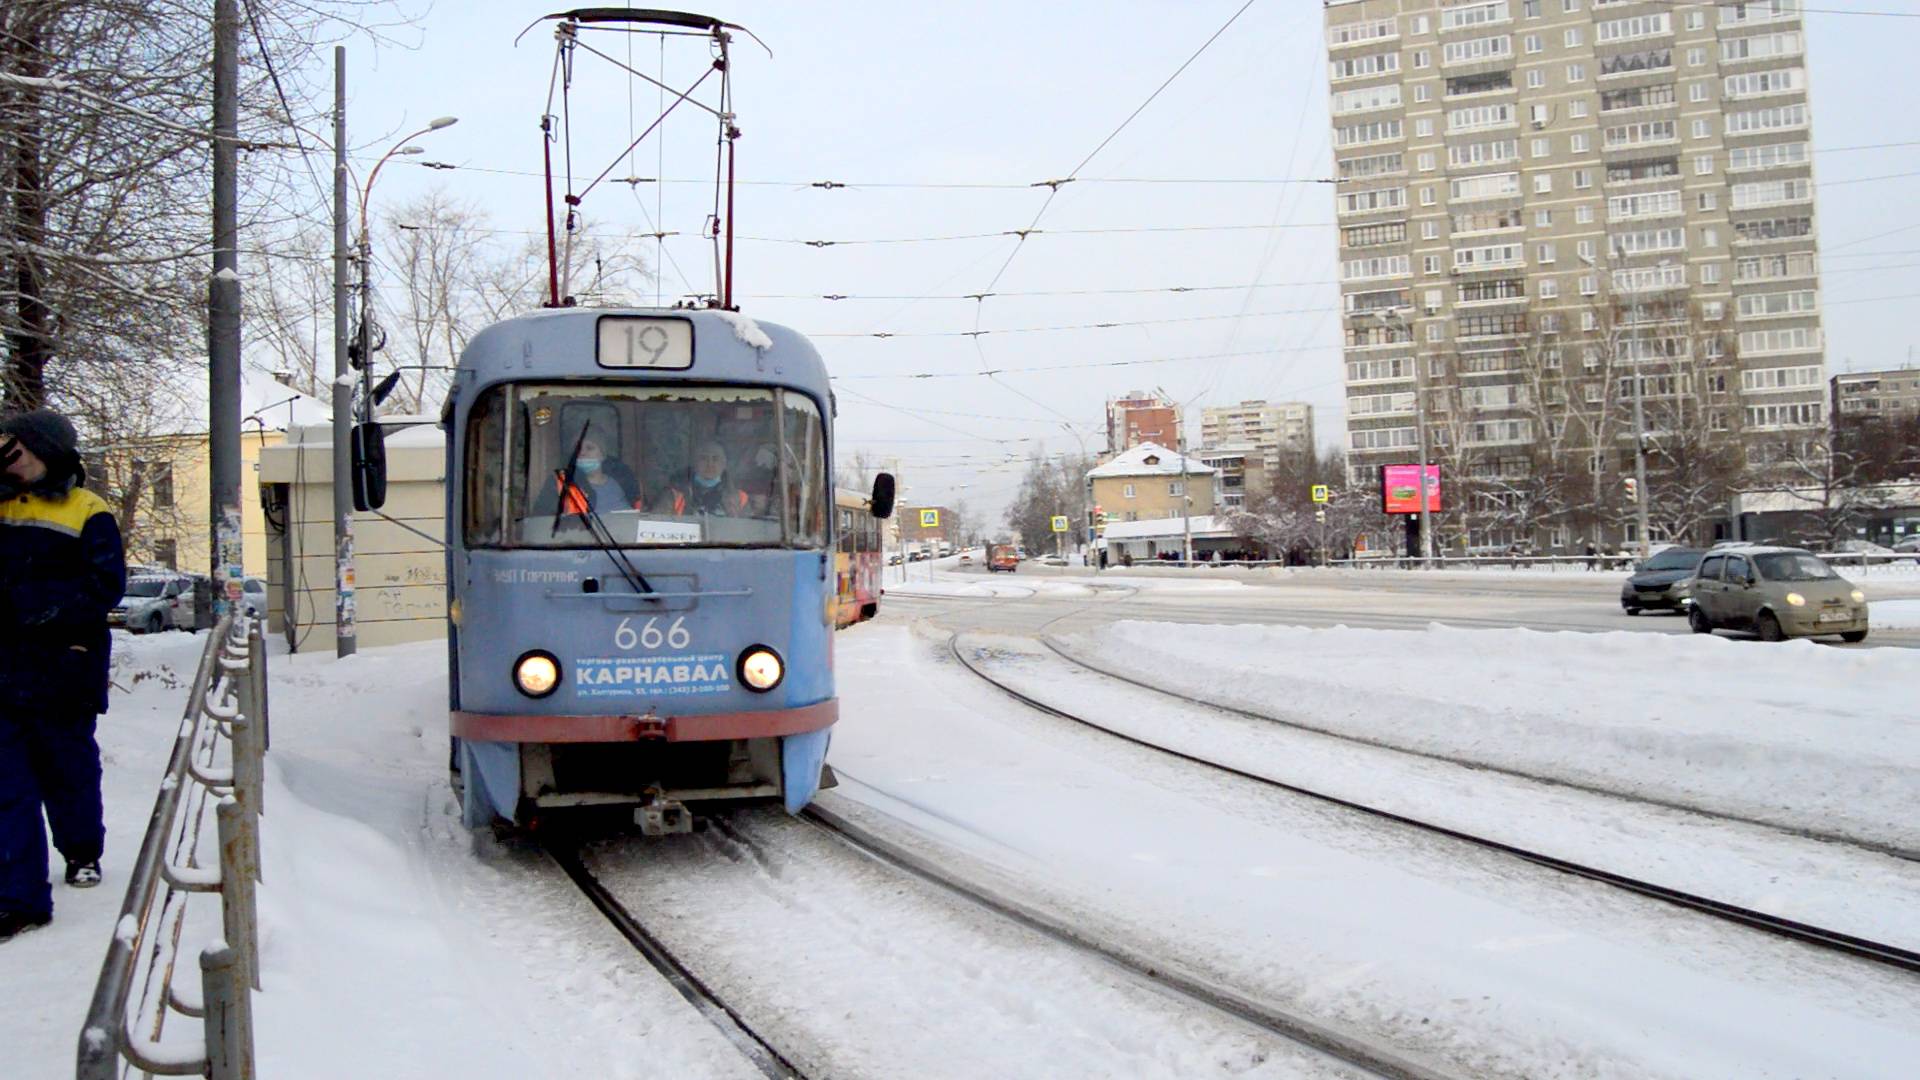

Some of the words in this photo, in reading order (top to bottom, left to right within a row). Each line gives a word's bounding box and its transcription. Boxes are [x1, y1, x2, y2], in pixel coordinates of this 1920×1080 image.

[624, 326, 668, 364] 19
[615, 616, 689, 649] 666
[576, 663, 729, 685] КАРНАВАЛ
